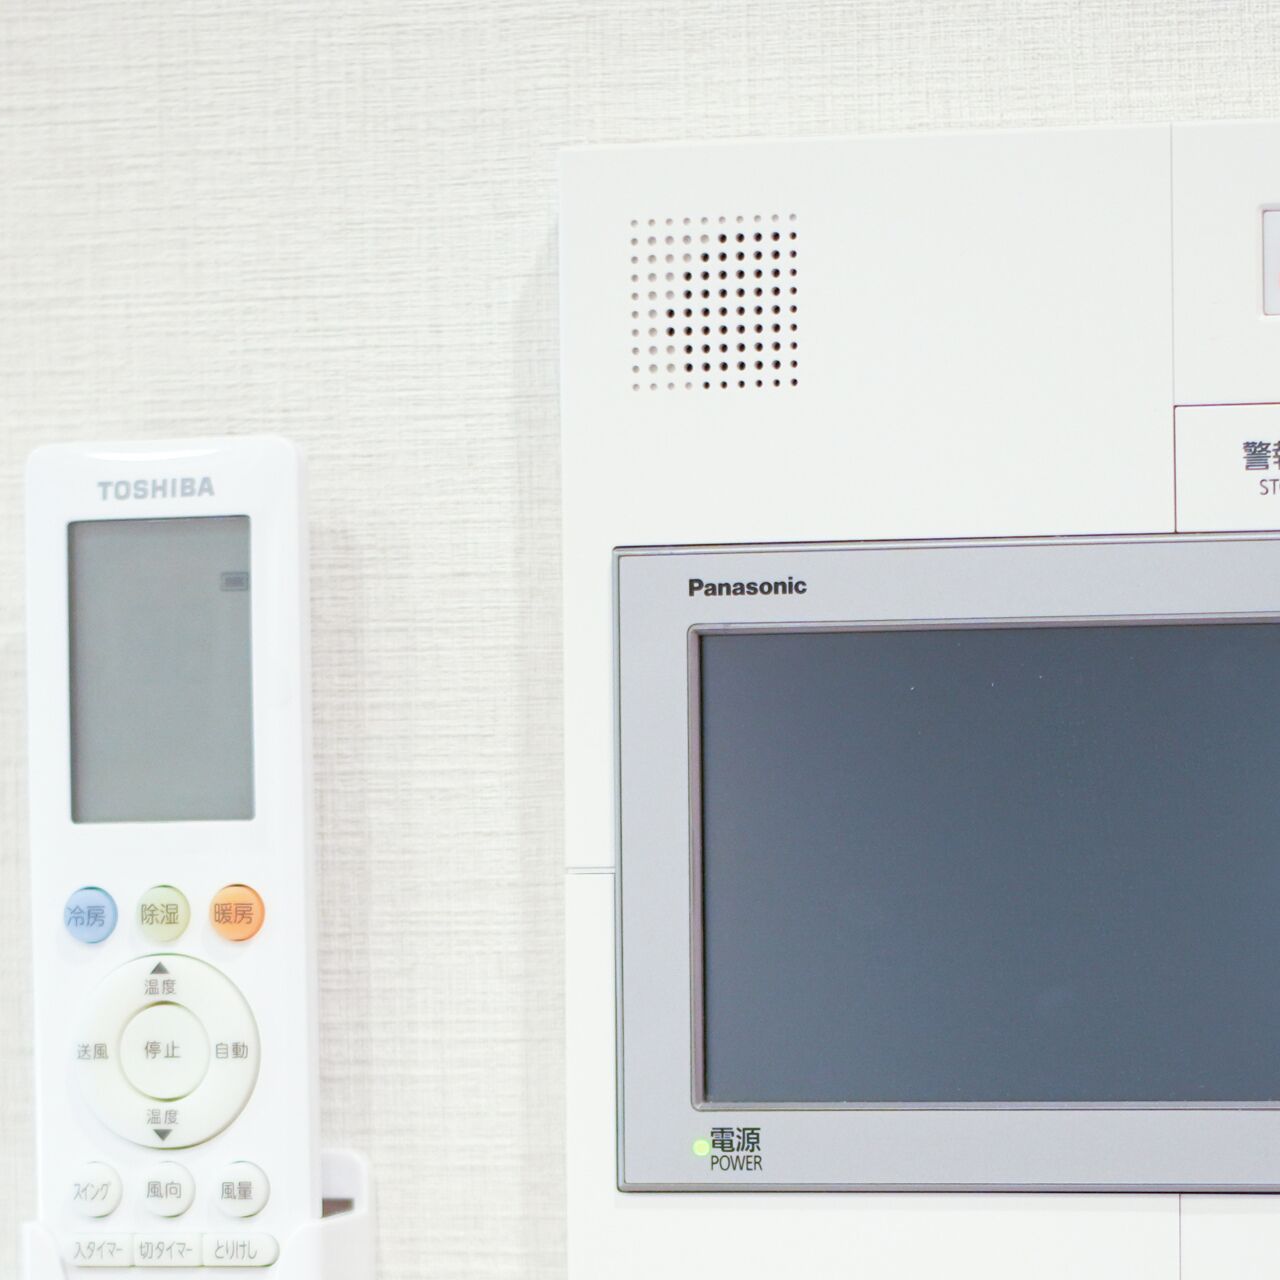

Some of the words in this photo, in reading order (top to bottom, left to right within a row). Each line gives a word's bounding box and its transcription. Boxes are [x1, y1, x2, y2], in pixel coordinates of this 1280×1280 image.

[97, 477, 215, 501] TOSHIBA
[688, 576, 808, 597] Panasonic
[67, 904, 105, 928] 冷房
[140, 903, 179, 925] 除湿
[214, 902, 254, 925] 暖房
[144, 978, 176, 996] 温度
[77, 1043, 109, 1061] 送風
[144, 1041, 181, 1060] 停止
[215, 1041, 248, 1060] 自動
[146, 1108, 179, 1125] 温度
[710, 1127, 762, 1153] 電源
[710, 1155, 763, 1171] POWER
[73, 1181, 111, 1201] スイング
[146, 1181, 182, 1200] 風向
[221, 1181, 253, 1201] 風量
[139, 1241, 193, 1260] 切タイマー
[214, 1240, 258, 1260] とりけし
